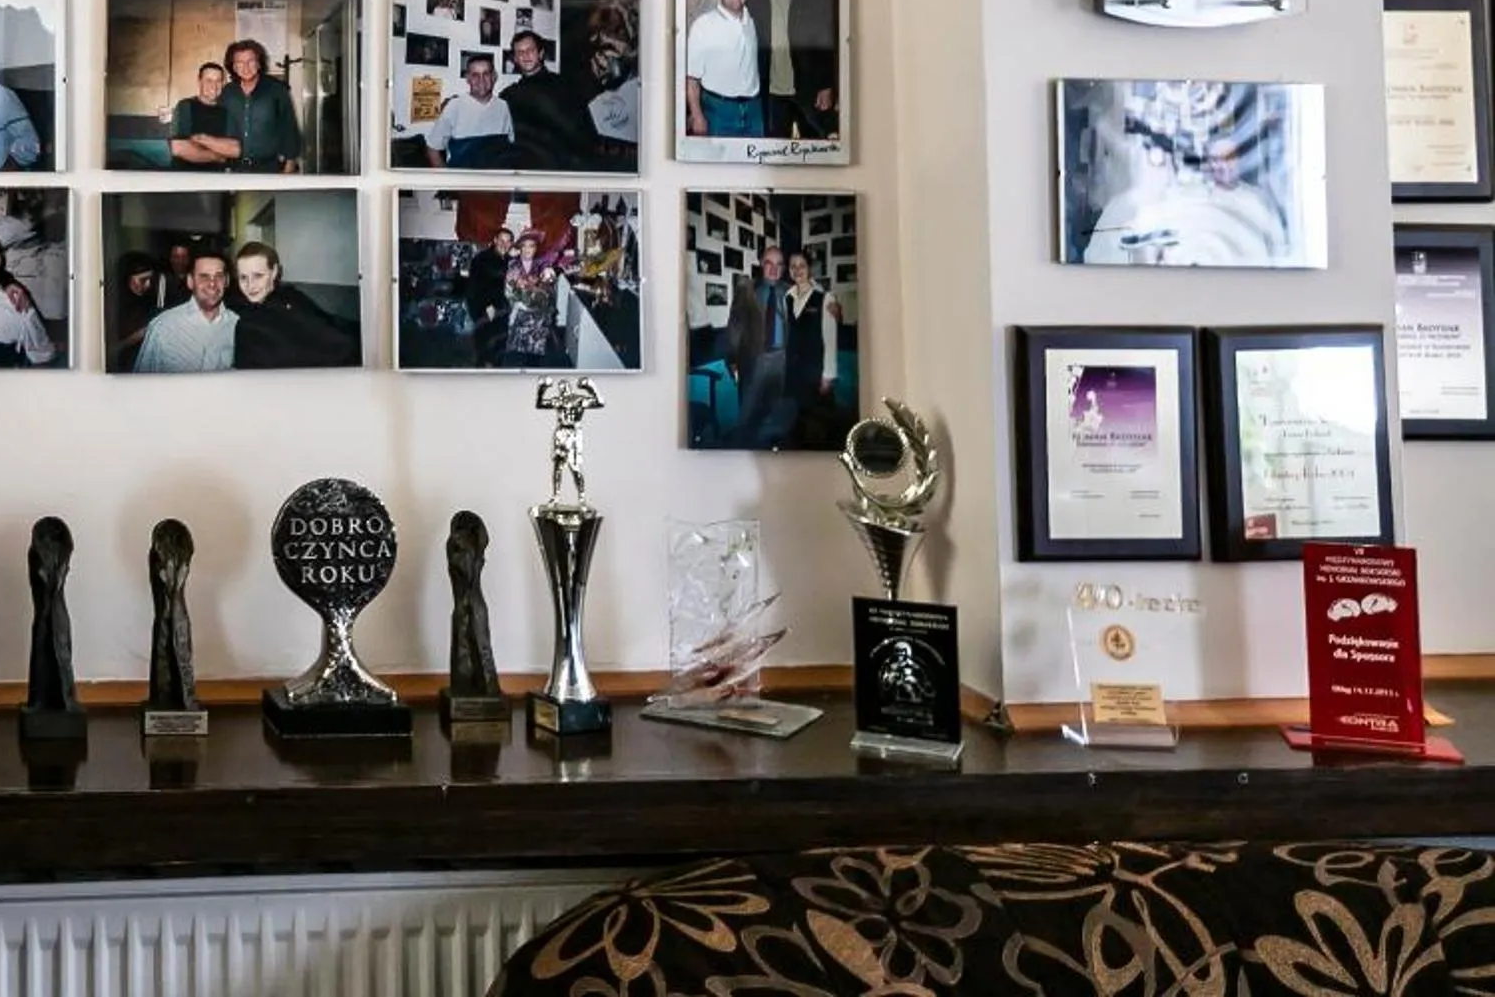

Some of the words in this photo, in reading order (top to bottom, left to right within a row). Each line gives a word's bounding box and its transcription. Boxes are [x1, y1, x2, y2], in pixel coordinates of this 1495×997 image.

[290, 516, 384, 536] DOBRO
[301, 564, 375, 584] ROKU
[1328, 633, 1399, 649] Podziękowanie
